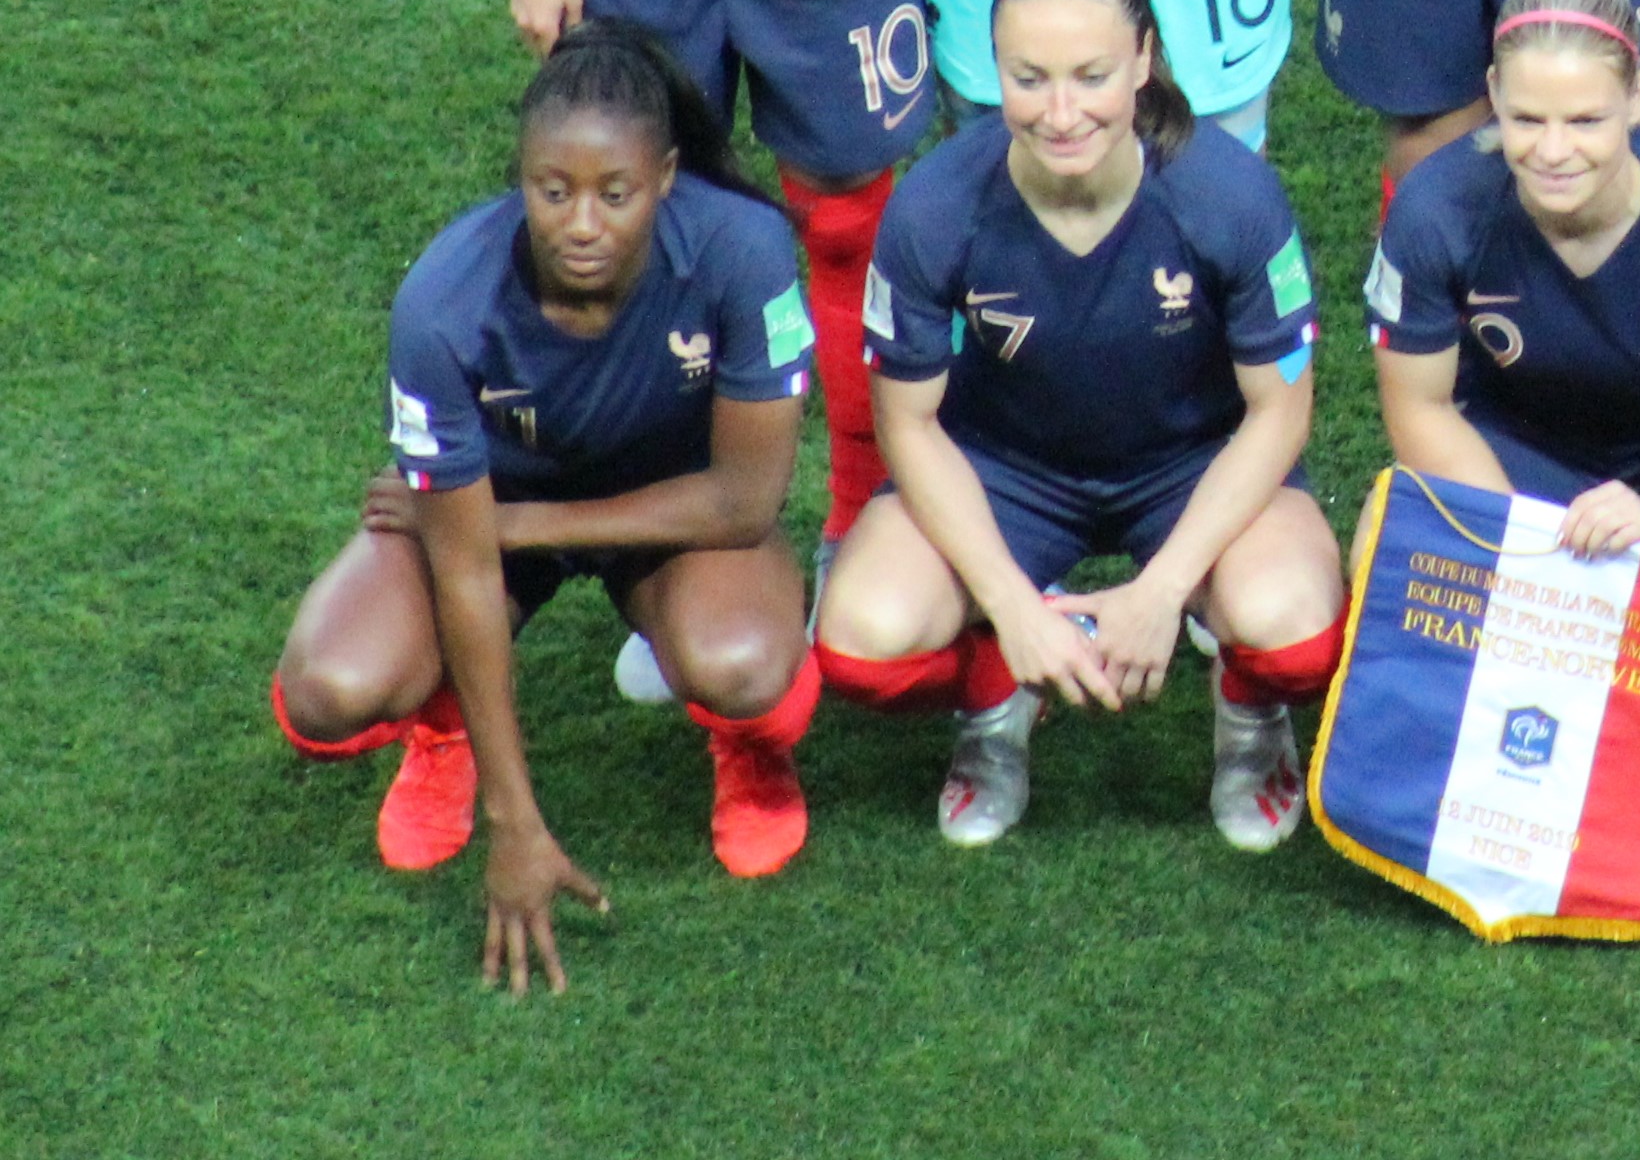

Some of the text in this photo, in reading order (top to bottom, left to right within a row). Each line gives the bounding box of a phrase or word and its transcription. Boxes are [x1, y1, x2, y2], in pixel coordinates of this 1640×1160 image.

[848, 1, 929, 113] 10
[1409, 551, 1461, 582] COUPE
[1460, 564, 1484, 587] DU
[1483, 570, 1536, 604] MONDE
[1537, 584, 1560, 609] DE
[1562, 591, 1582, 612] LA
[1406, 580, 1482, 616] EQUIPE
[1485, 601, 1513, 626] DE
[1515, 610, 1599, 646] FRANCE
[1437, 796, 1462, 820] 12
[1464, 804, 1526, 837] JUIN
[1469, 835, 1533, 870] NICE
